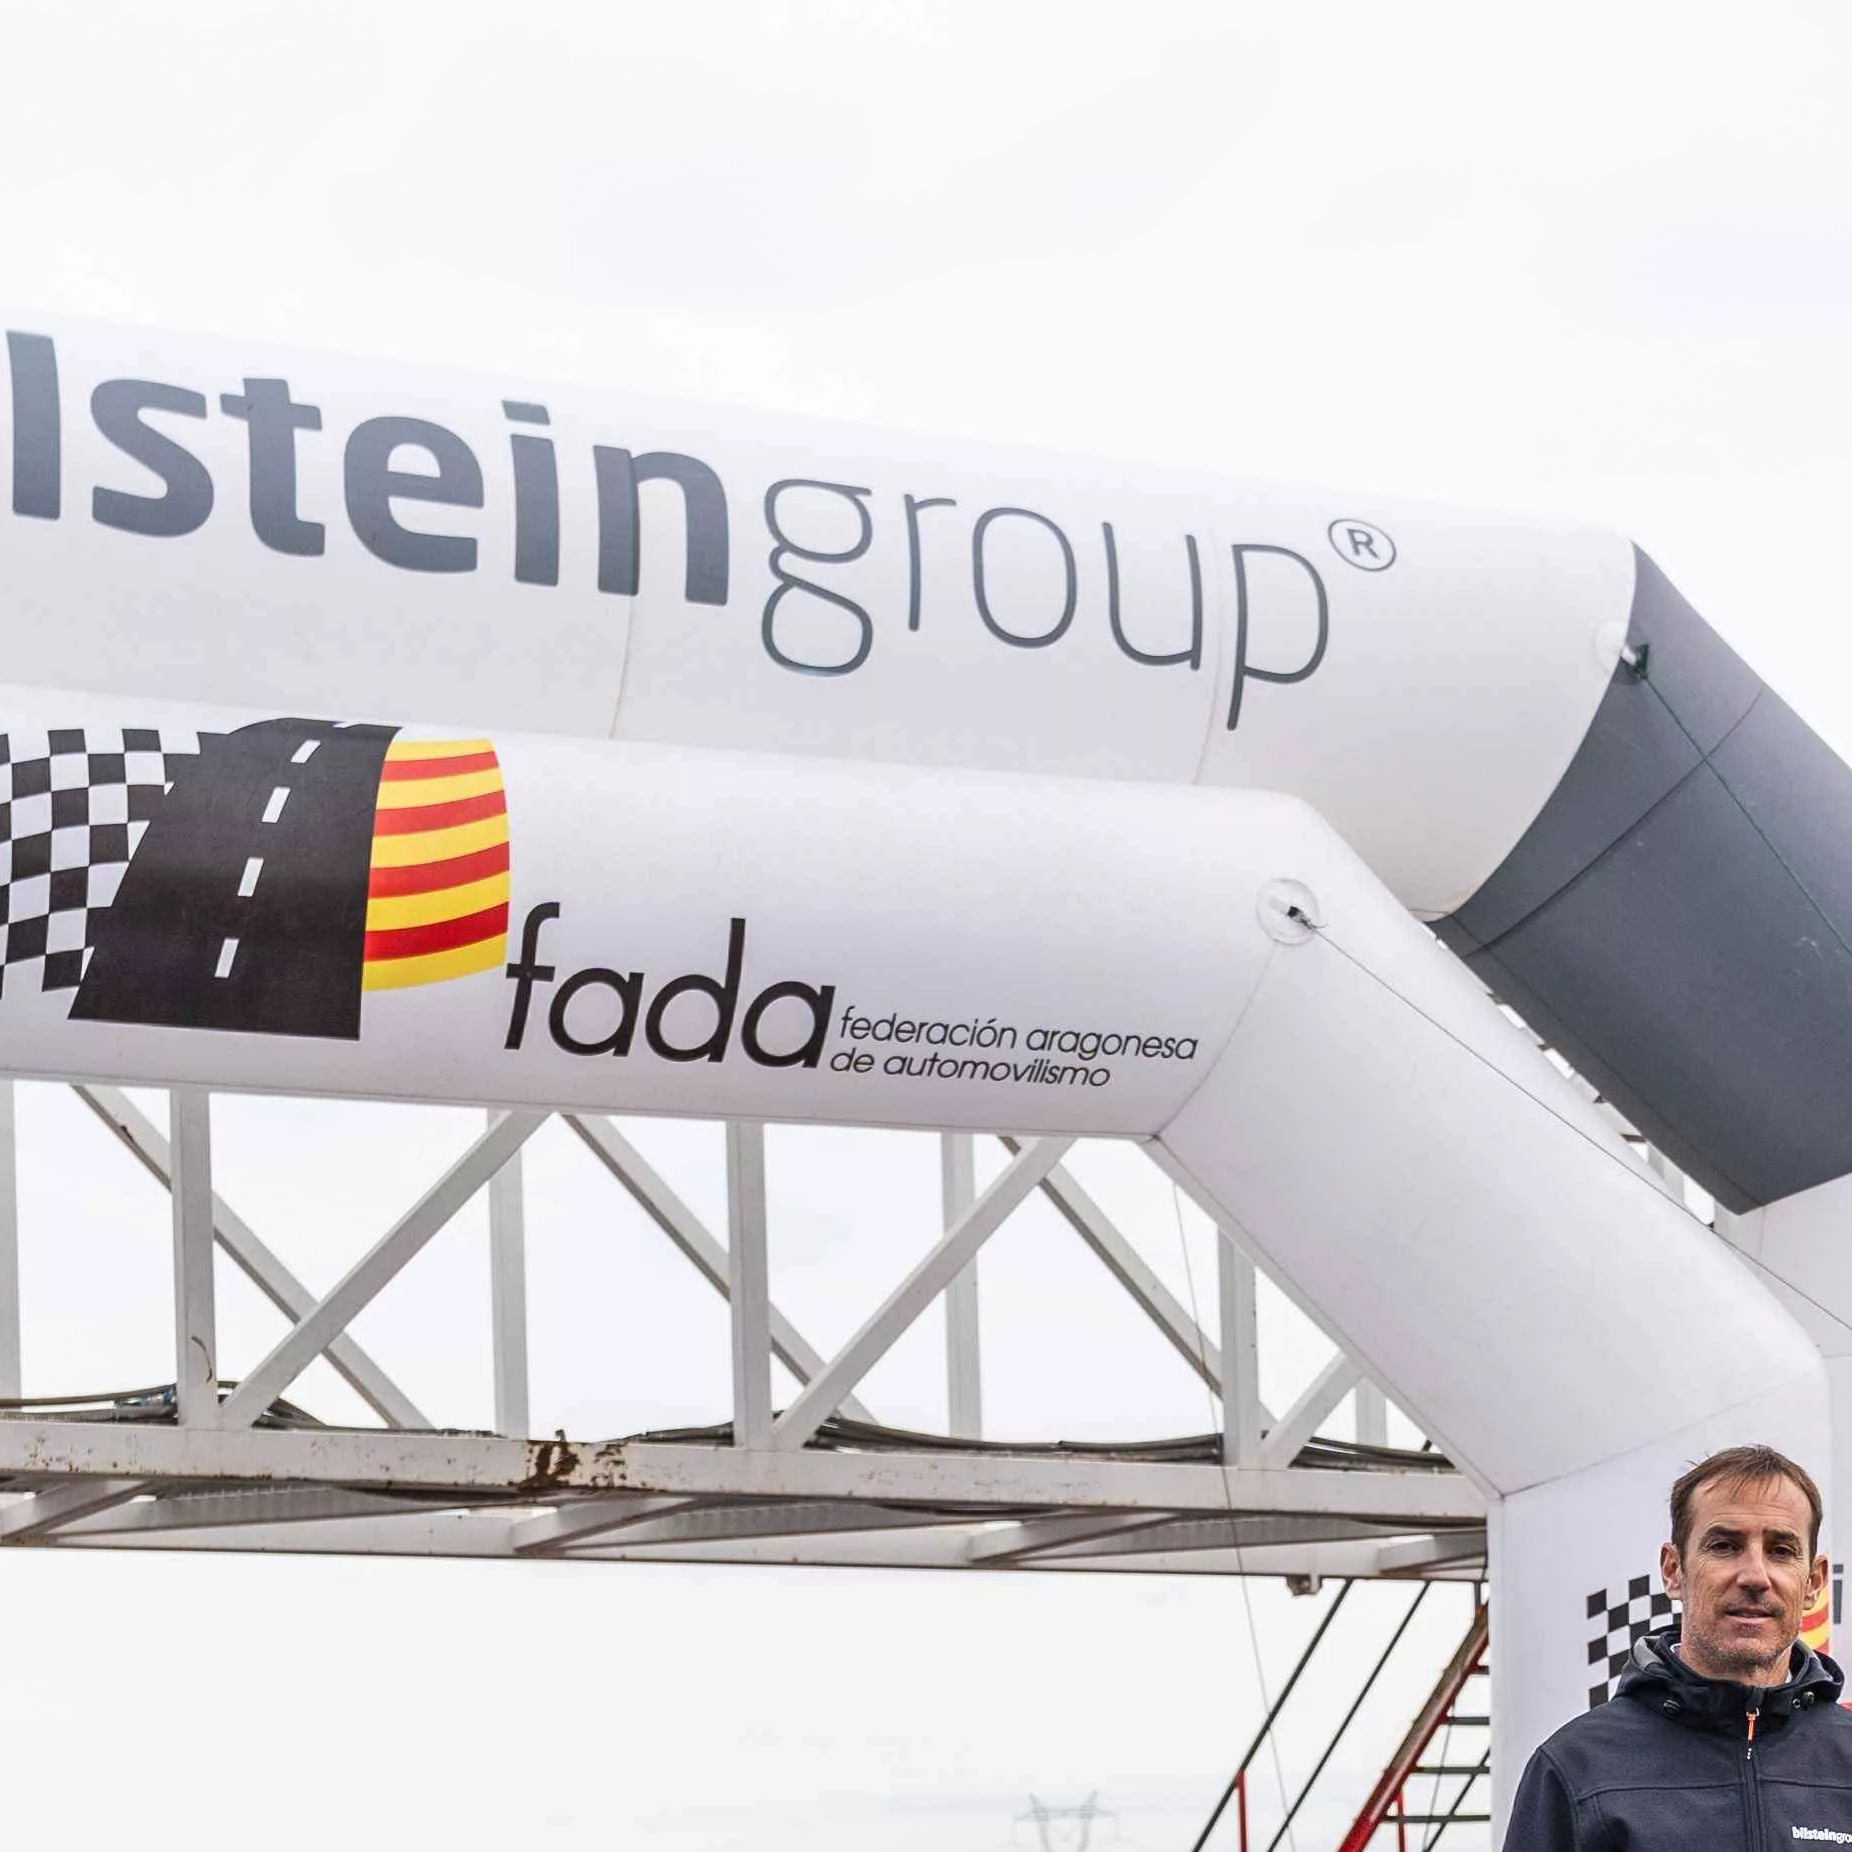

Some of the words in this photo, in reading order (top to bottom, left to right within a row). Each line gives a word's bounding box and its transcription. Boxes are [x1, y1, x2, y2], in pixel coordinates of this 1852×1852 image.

[504, 901, 836, 1070] fada
[840, 1005, 1017, 1052] federación
[1025, 1028, 1198, 1061] aragonesa
[829, 1047, 876, 1074] de
[882, 1050, 1112, 1088] automovilismo
